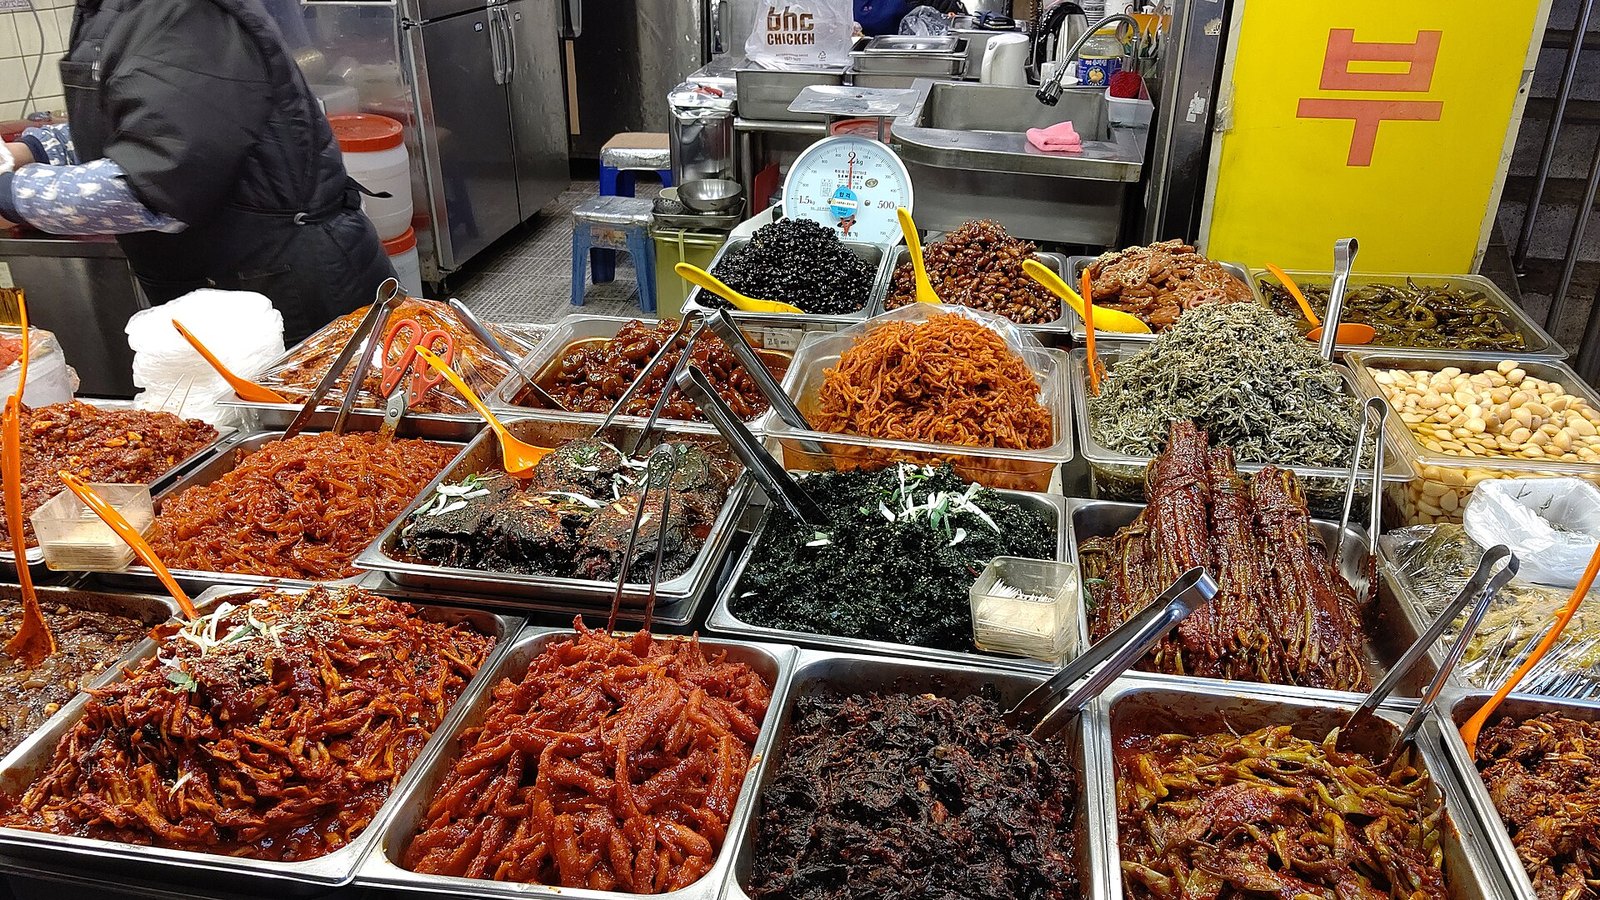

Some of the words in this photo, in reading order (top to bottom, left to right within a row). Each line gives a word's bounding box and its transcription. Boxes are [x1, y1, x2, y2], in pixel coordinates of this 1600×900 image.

[767, 6, 815, 31] bhc
[767, 33, 815, 45] CHICKEN
[1296, 28, 1444, 167] 부
